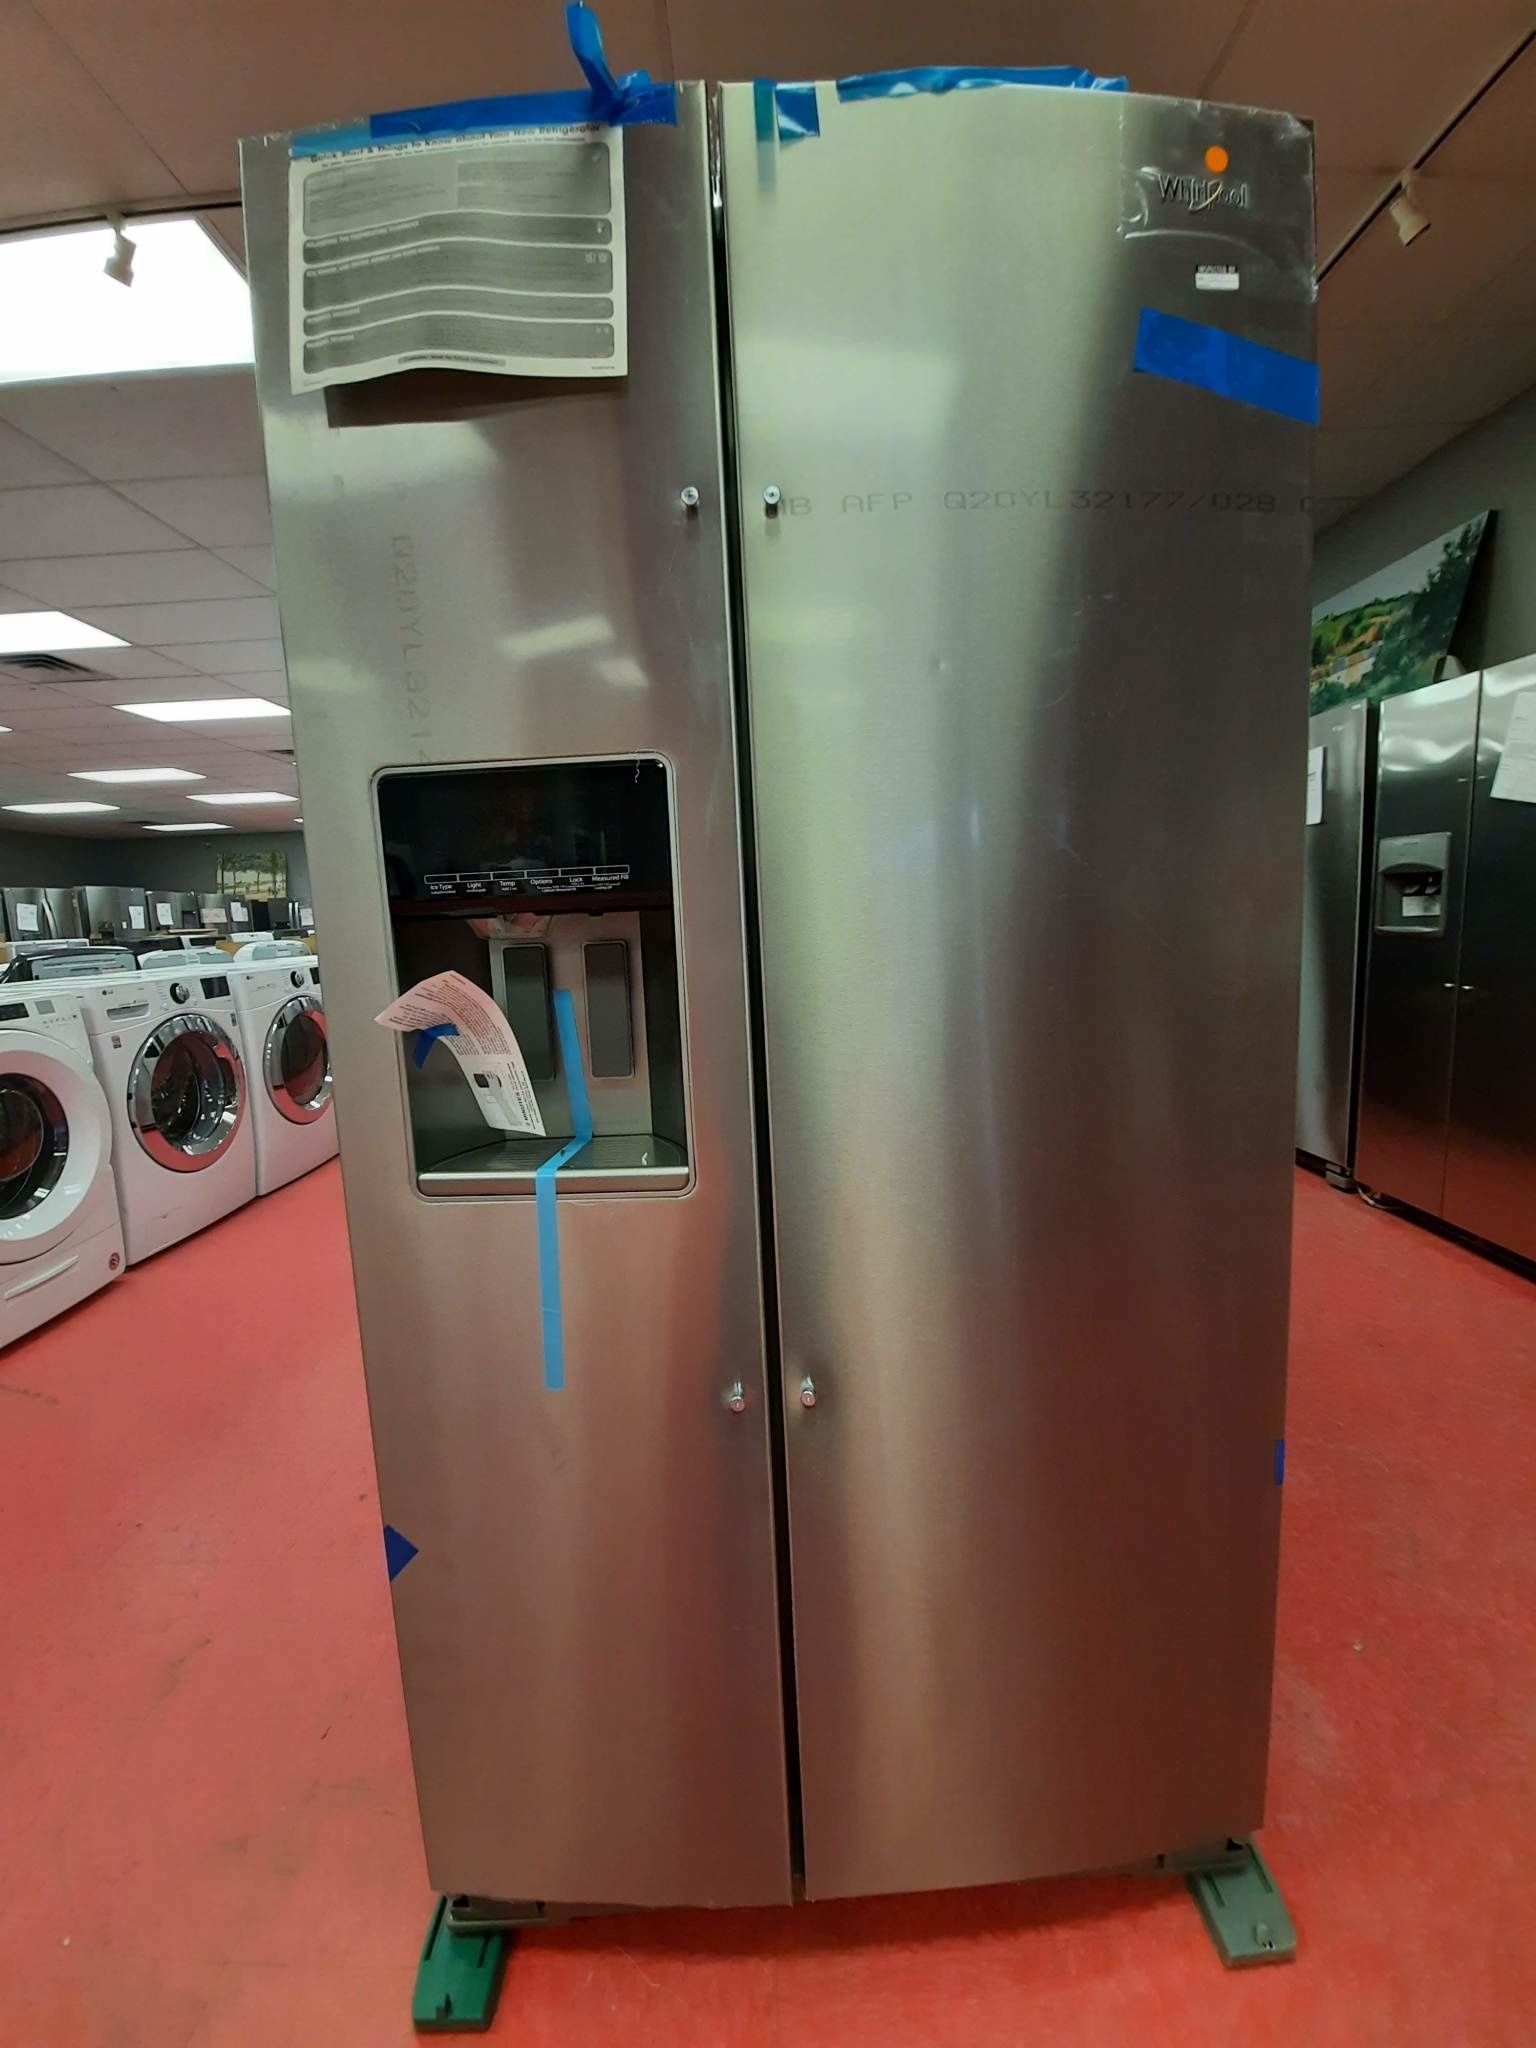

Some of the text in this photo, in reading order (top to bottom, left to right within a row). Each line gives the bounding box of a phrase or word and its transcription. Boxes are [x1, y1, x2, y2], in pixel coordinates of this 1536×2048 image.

[841, 491, 913, 513] AFP
[499, 880, 516, 888] Temp
[530, 878, 553, 886] Options
[439, 883, 453, 891] Type
